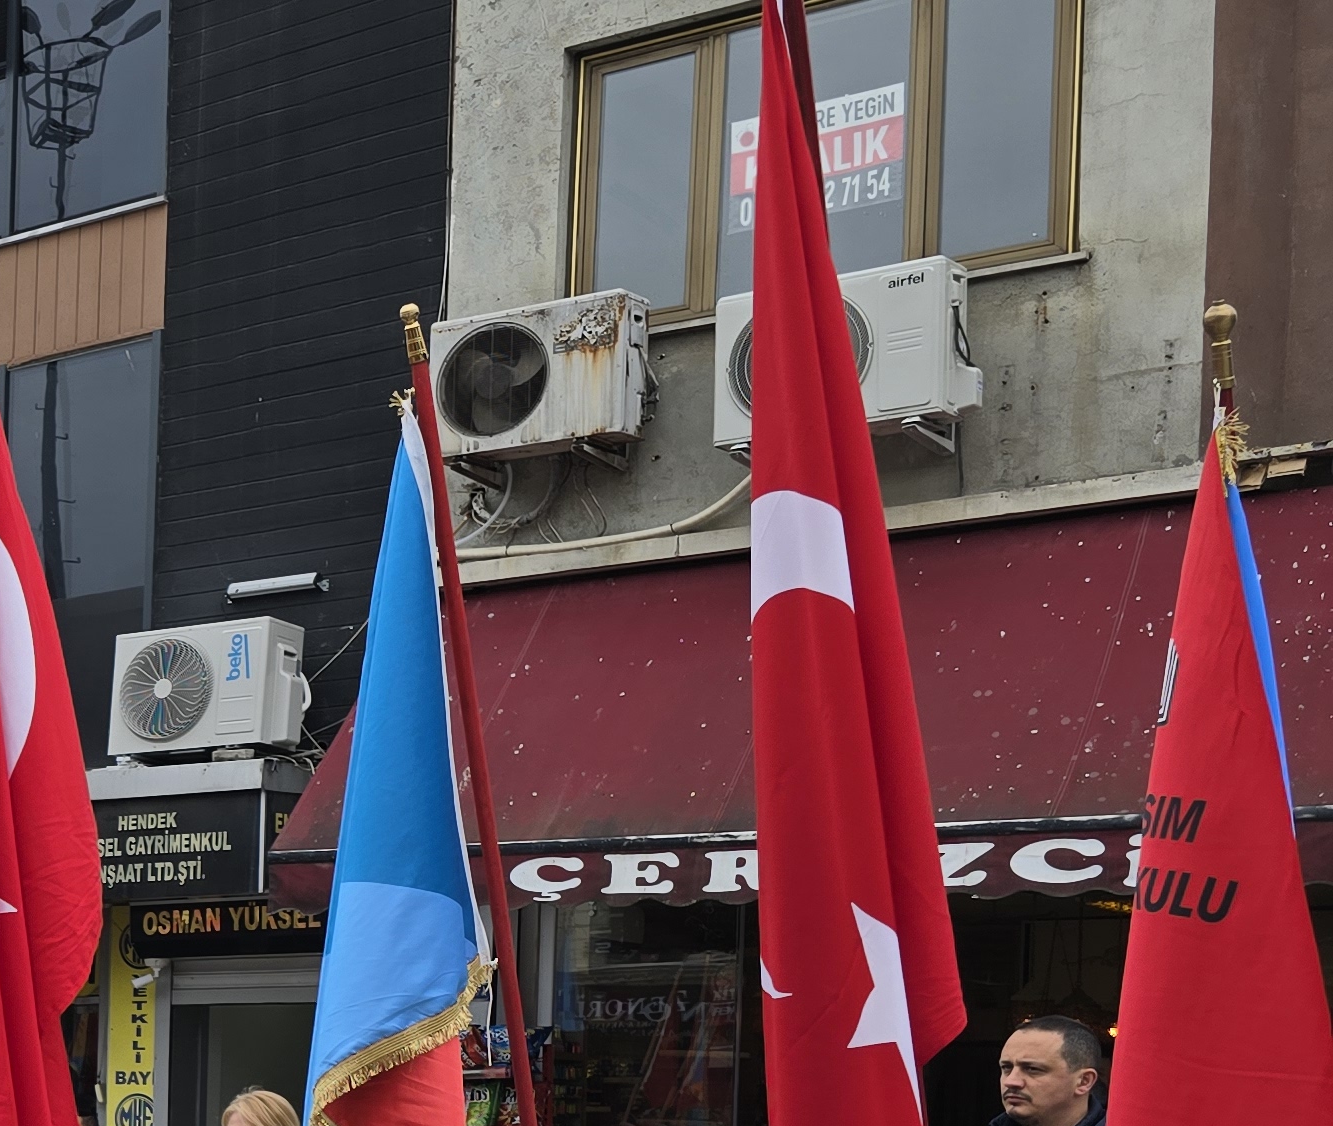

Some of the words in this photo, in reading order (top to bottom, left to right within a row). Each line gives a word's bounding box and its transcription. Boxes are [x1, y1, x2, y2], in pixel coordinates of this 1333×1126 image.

[841, 174, 861, 206] 71
[866, 166, 891, 200] 54
[888, 272, 924, 289] airfel
[225, 633, 243, 681] beko
[117, 811, 178, 832] HENDEK
[125, 829, 232, 856] GAYRİMENKUL
[142, 907, 222, 936] OSMAN
[228, 902, 322, 932] YÜKSEL
[115, 1066, 155, 1086] BAY
